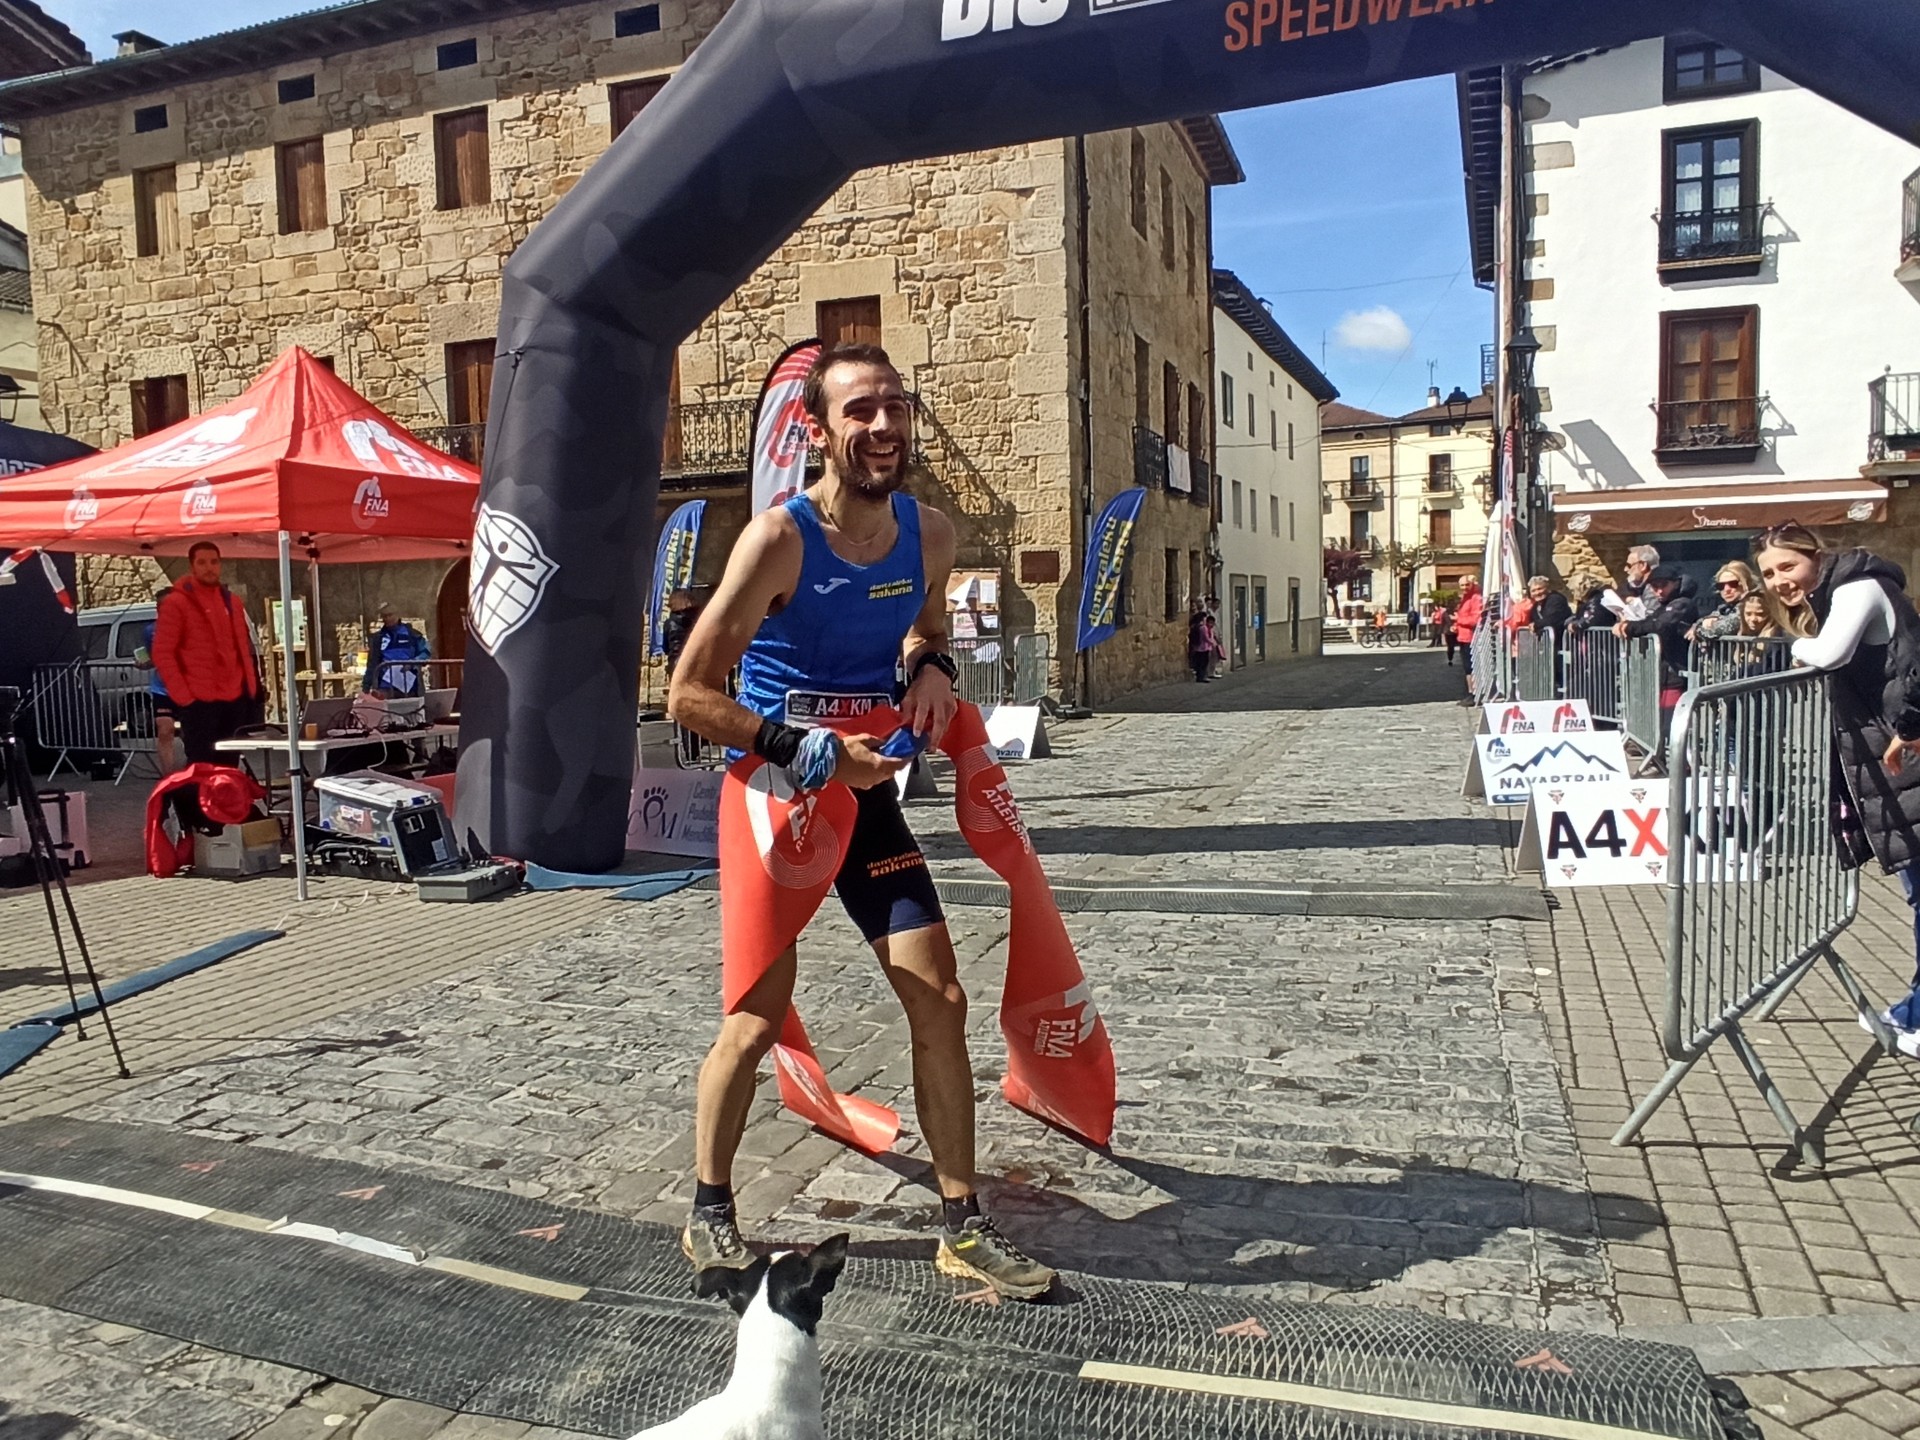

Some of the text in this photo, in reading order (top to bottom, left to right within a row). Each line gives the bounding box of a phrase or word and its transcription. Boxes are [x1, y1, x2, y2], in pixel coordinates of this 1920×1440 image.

[1224, 0, 1494, 51] SPEEDW
[365, 498, 389, 511] FNA
[1089, 516, 1117, 627] dantzaleku
[1512, 721, 1535, 731] FNA
[1564, 719, 1587, 729] FNA
[1494, 748, 1511, 756] FNA
[1046, 1018, 1076, 1058] FNA
